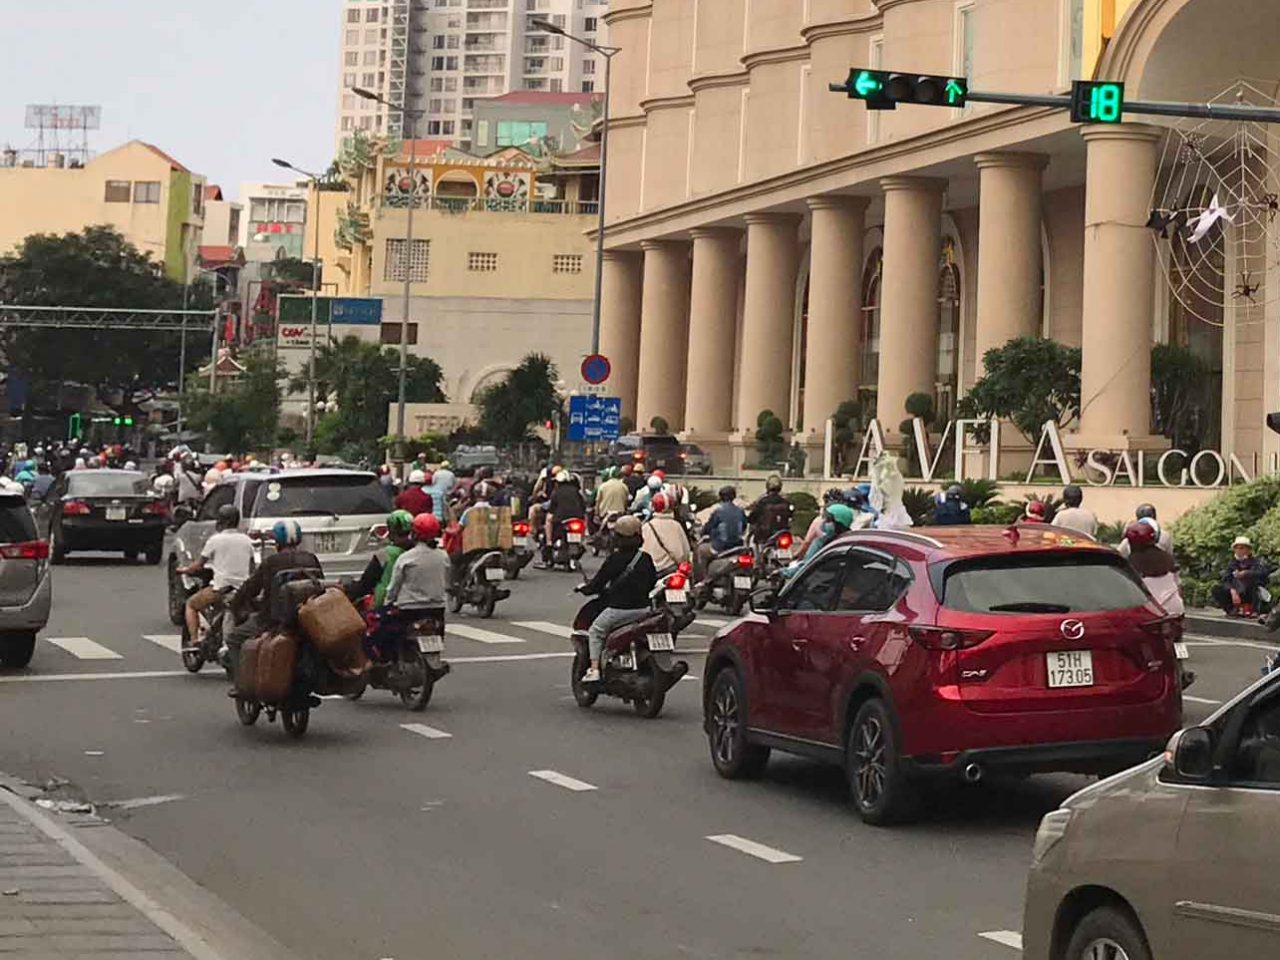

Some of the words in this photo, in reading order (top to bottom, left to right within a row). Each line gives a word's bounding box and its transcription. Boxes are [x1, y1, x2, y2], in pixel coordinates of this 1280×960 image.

[1090, 84, 1119, 121] 18
[1086, 448, 1257, 488] SAIGON
[1057, 652, 1082, 668] 51H
[1050, 667, 1093, 686] 173.05
